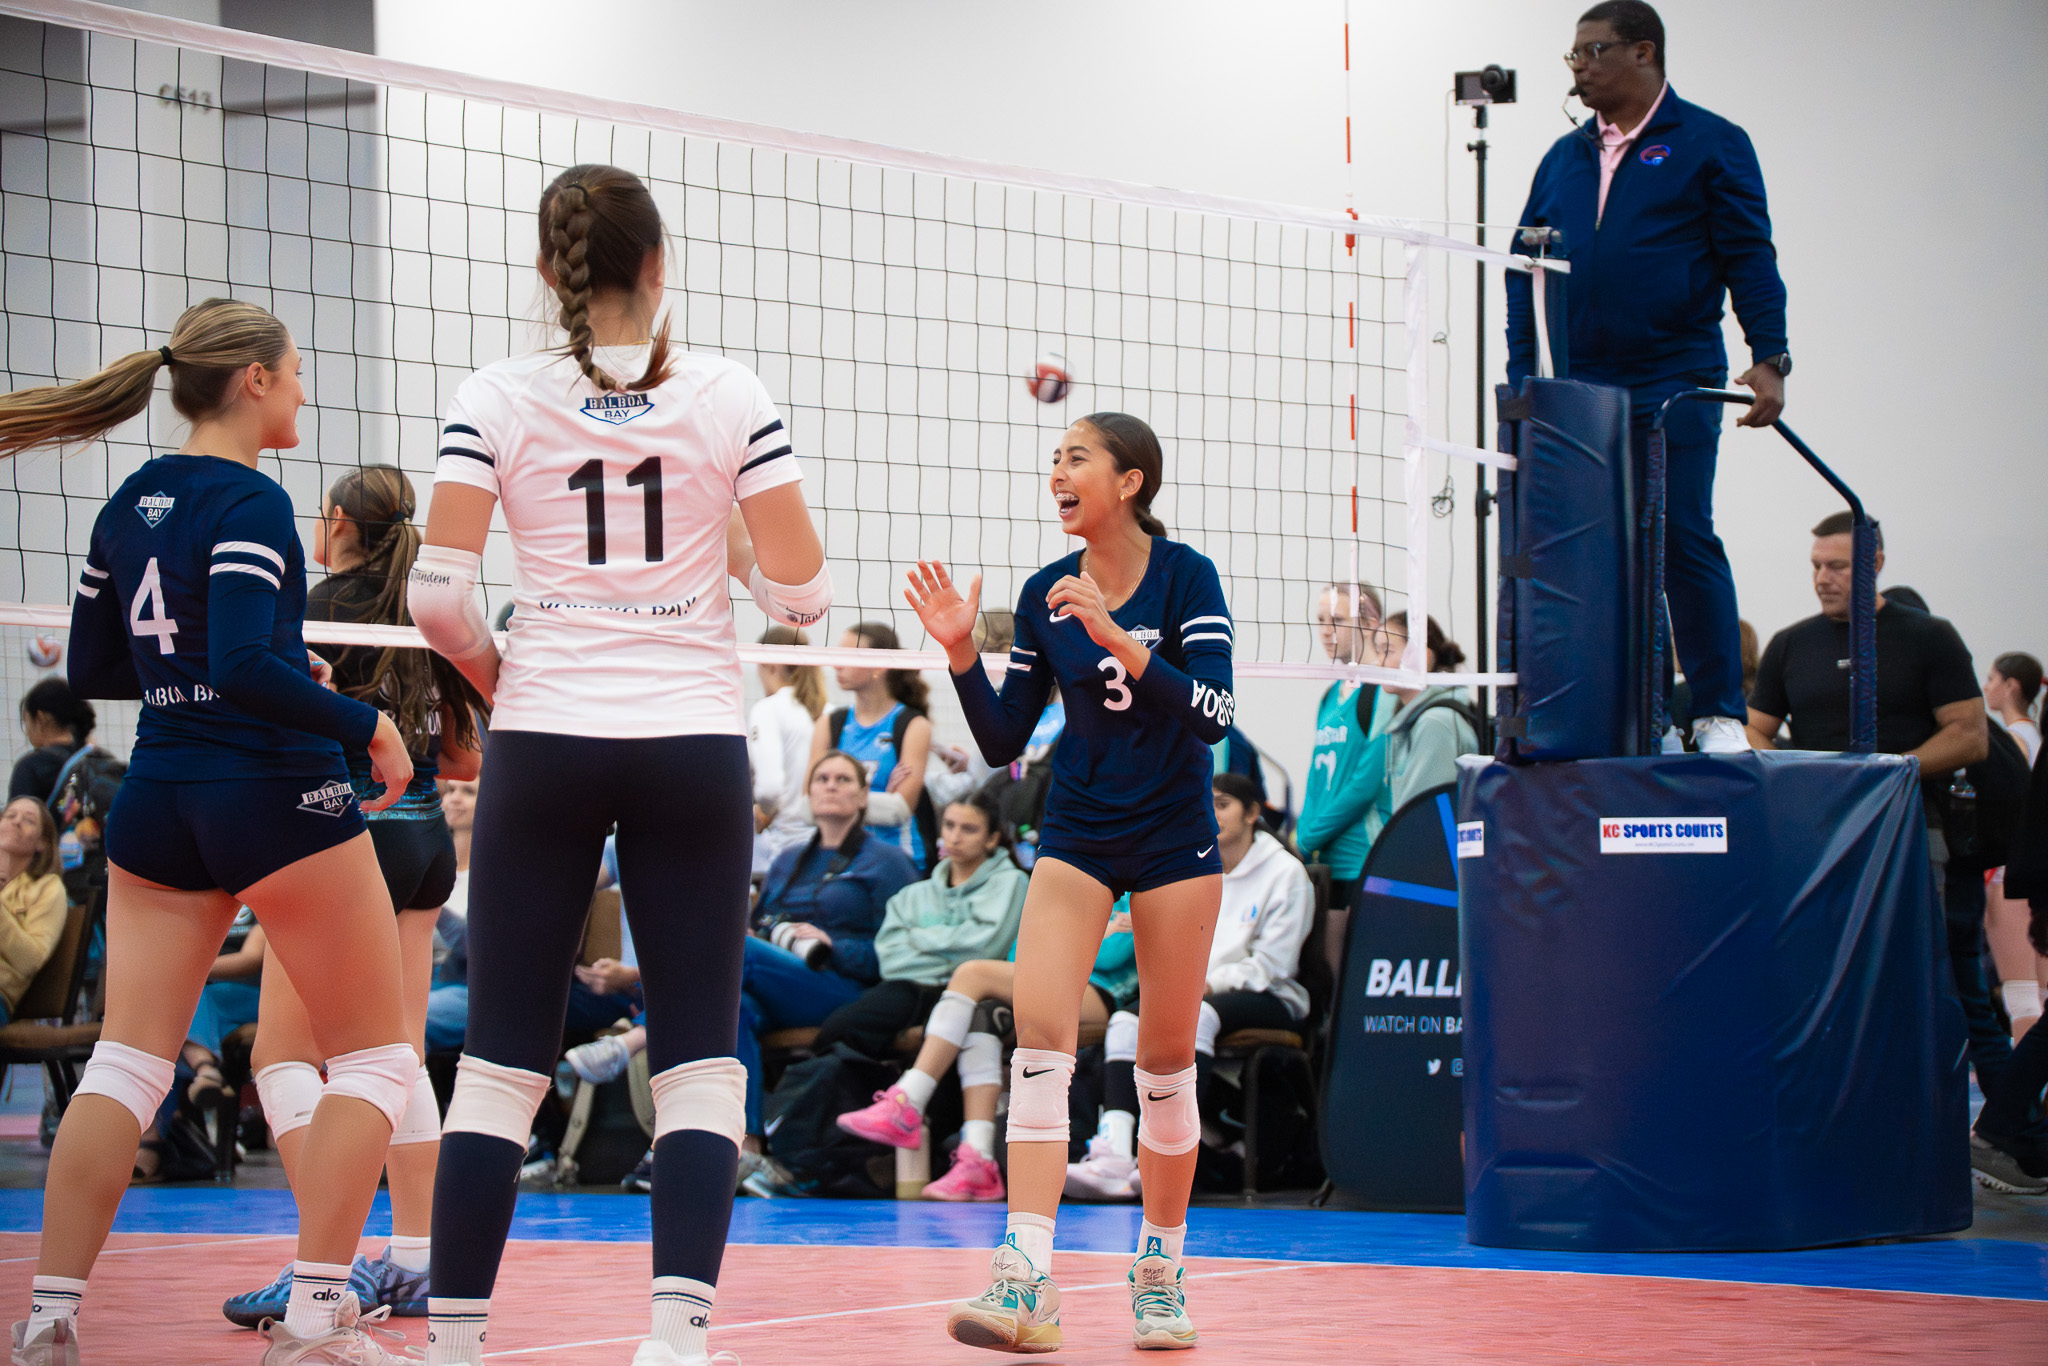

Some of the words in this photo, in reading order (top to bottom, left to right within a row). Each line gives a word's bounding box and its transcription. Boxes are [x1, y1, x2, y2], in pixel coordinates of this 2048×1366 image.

[588, 395, 645, 409] BALBOA
[604, 409, 630, 418] BAY
[147, 508, 163, 518] BAY
[567, 456, 664, 565] 11
[129, 556, 179, 655] 4
[1097, 656, 1133, 711] 3
[306, 784, 351, 803] BALBOA
[323, 796, 344, 810] BAY
[1602, 824, 1620, 838] KC
[1623, 824, 1673, 839] SPORTS
[1675, 823, 1724, 838] COURTS
[1363, 1016, 1416, 1033] WATCH
[1418, 1016, 1441, 1033] ON
[312, 1288, 341, 1301] alo
